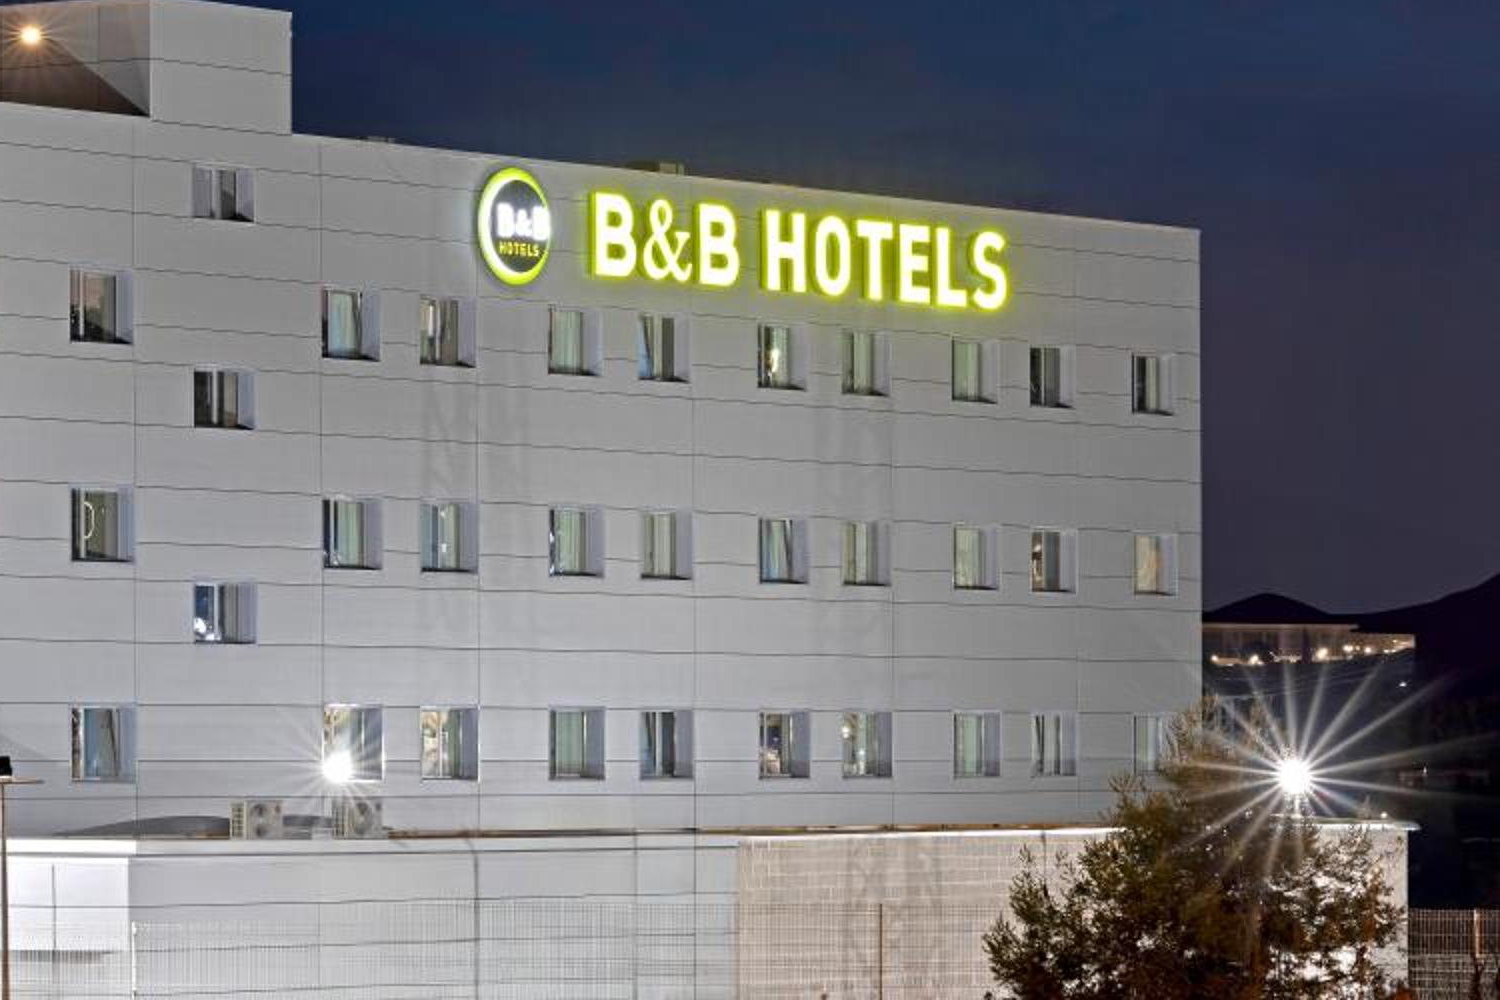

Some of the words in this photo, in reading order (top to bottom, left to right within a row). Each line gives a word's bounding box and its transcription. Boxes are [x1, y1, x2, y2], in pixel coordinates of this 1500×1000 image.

[497, 202, 550, 240] B&B
[499, 241, 539, 257] HOTELS
[590, 192, 741, 287] B&B
[763, 208, 1009, 311] HOTELS
